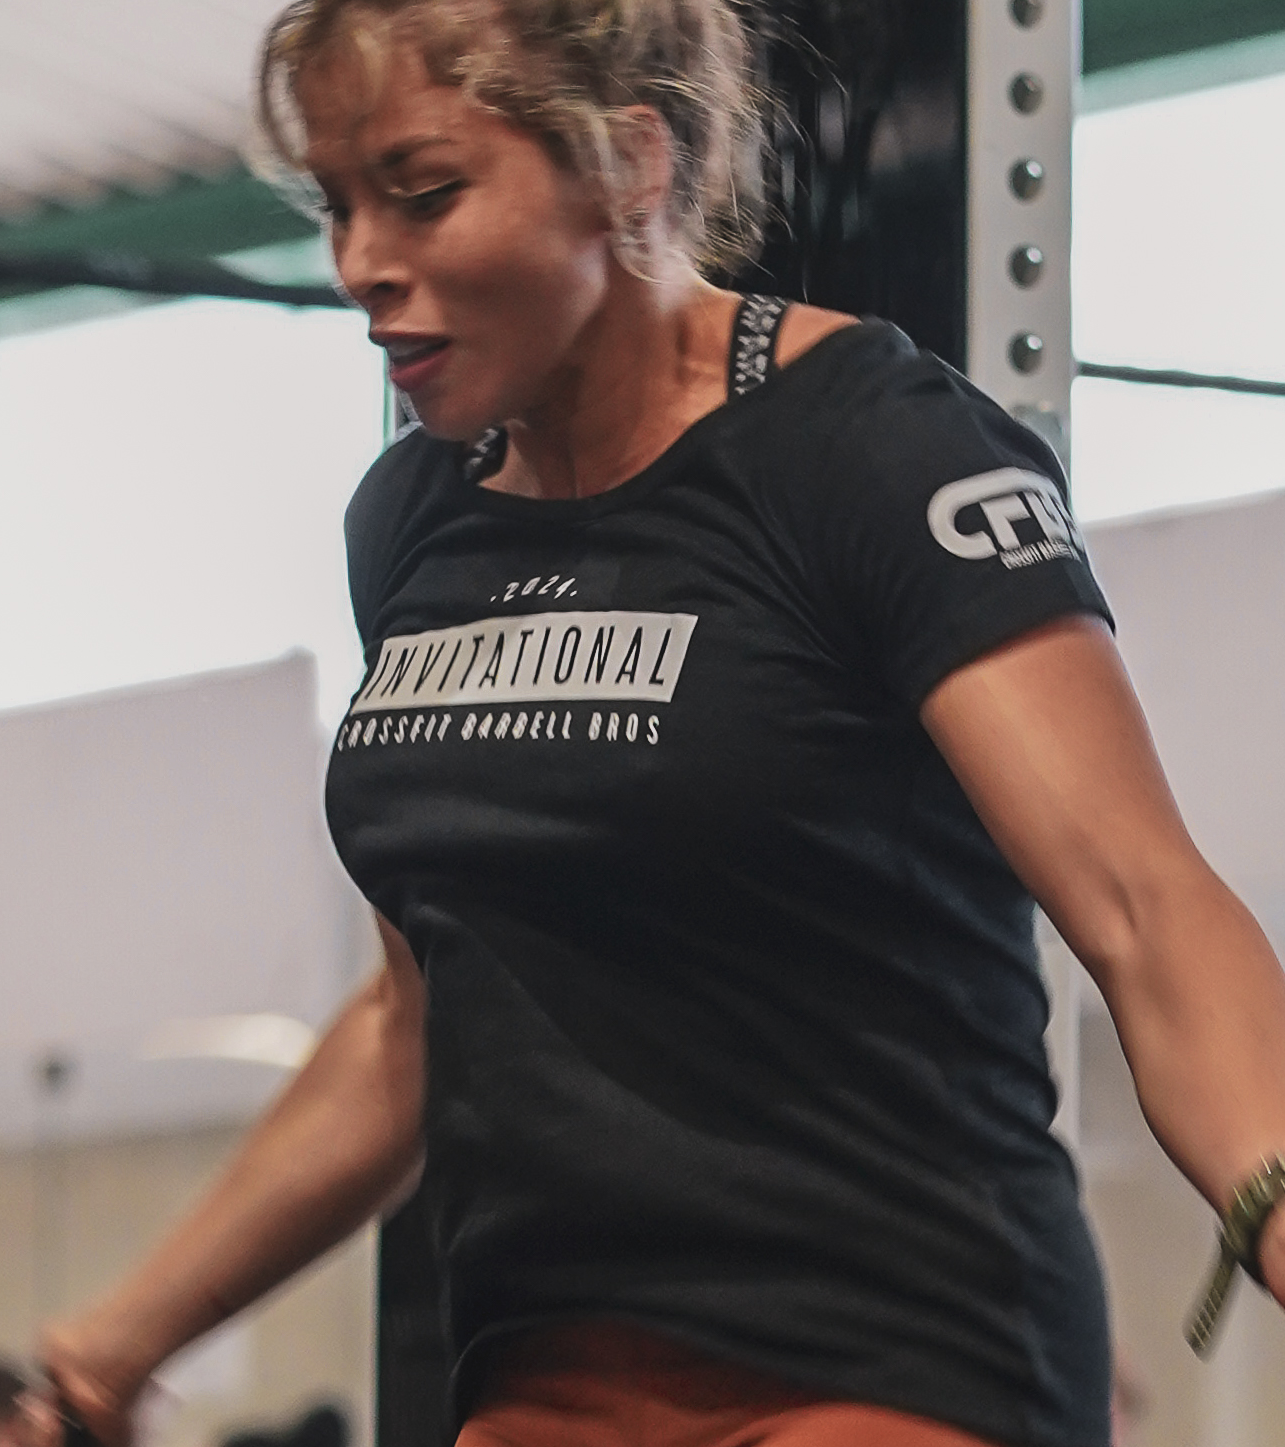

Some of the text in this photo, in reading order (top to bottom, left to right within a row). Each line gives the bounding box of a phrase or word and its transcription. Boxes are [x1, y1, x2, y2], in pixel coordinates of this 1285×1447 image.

[363, 625, 672, 701] INVITATIONAL
[460, 711, 572, 742] BARBELL
[588, 711, 660, 745] BROS
